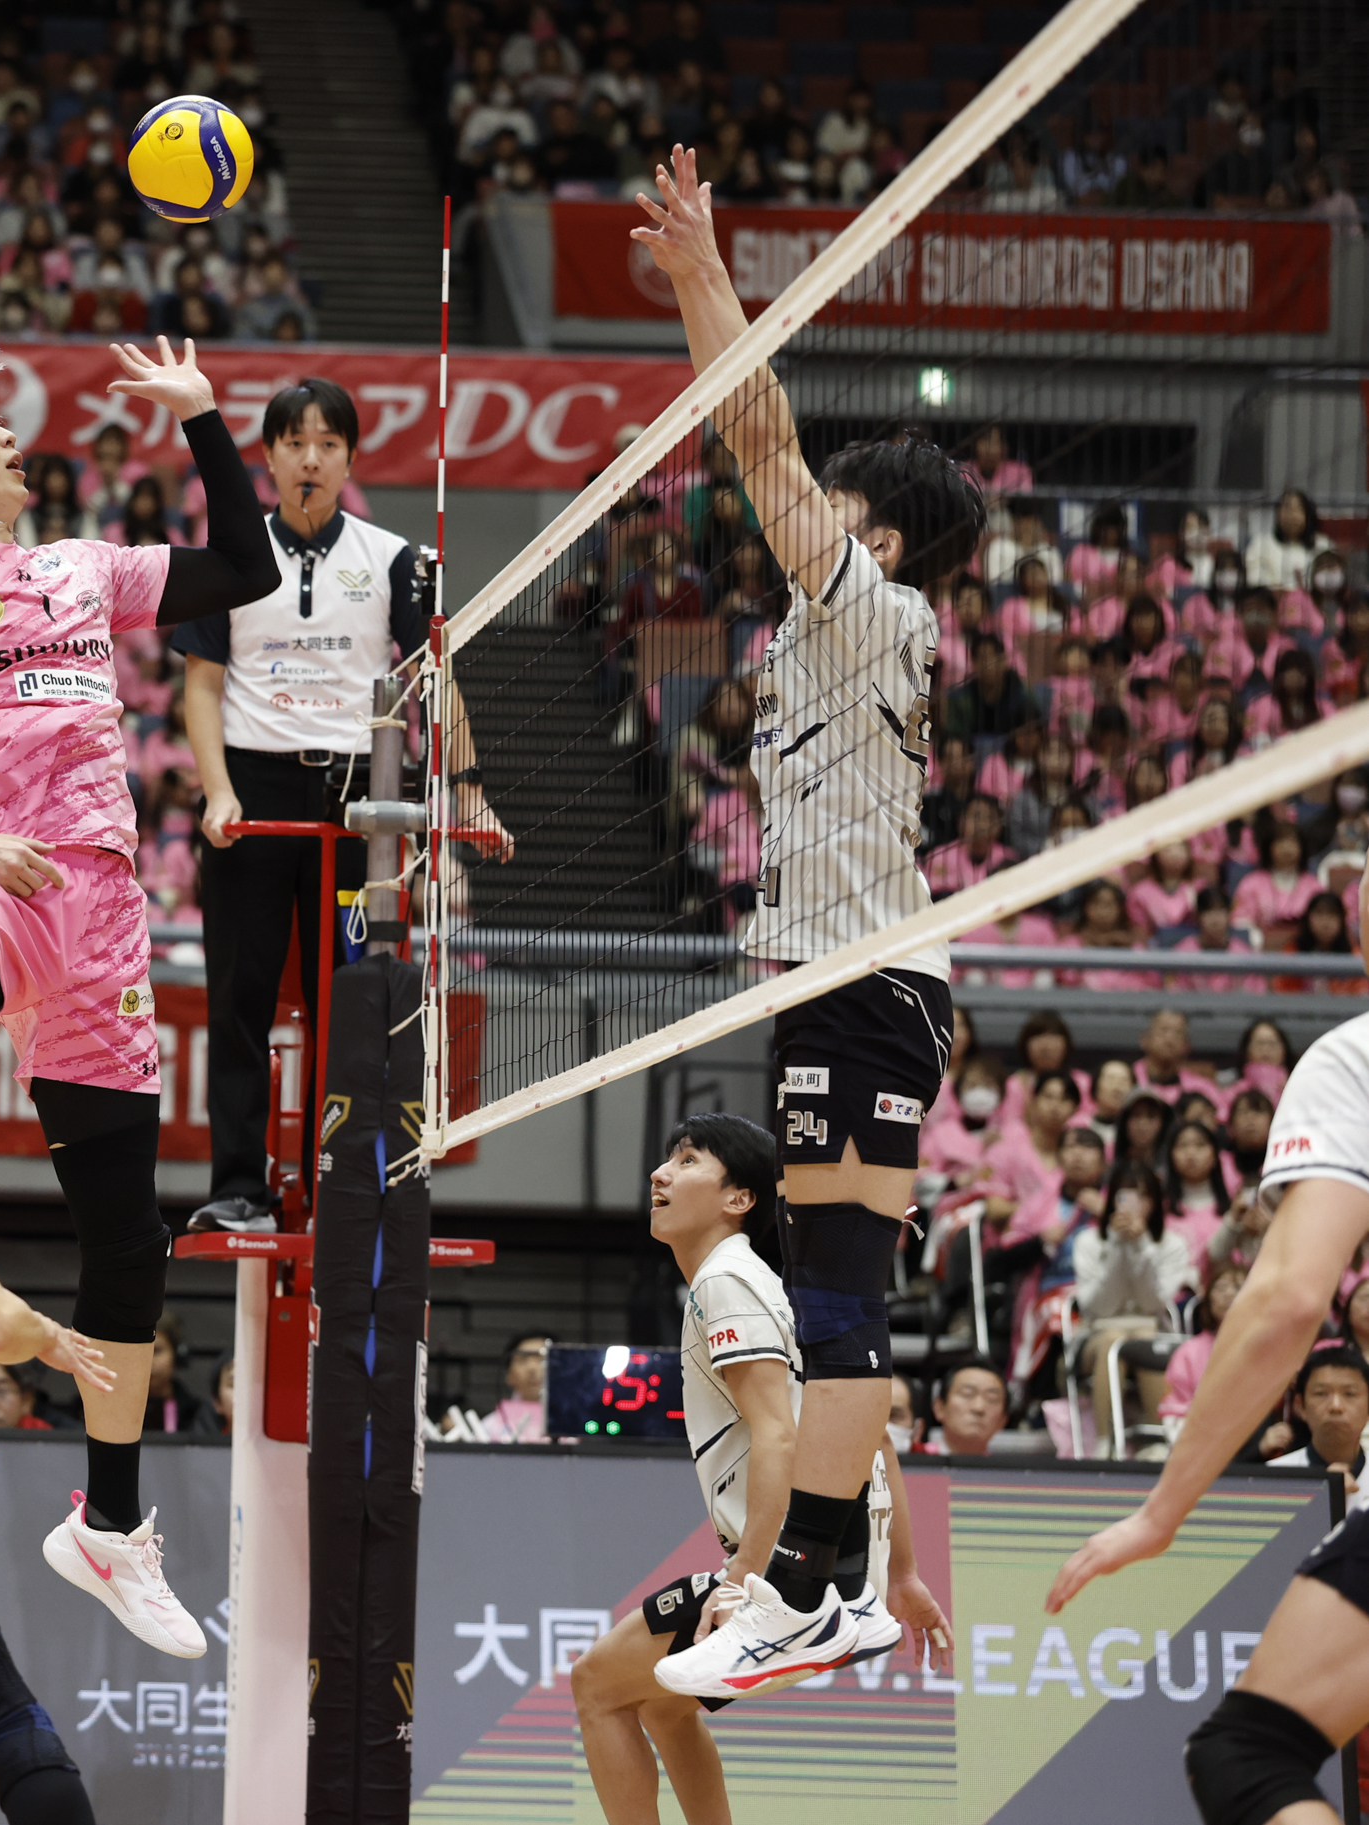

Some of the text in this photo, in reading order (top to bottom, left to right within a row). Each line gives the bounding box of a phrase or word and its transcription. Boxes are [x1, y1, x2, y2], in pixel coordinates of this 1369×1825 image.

[1121, 237, 1253, 311] OSAKA
[292, 635, 352, 651] 大同生命
[41, 673, 110, 694] Chuo Nittochi
[785, 1072, 822, 1088] 訪町
[786, 1110, 828, 1146] 24
[1273, 1136, 1312, 1158] TPR
[708, 1328, 739, 1349] TPR
[656, 1588, 684, 1616] 6
[76, 1678, 229, 1736] 大同生
